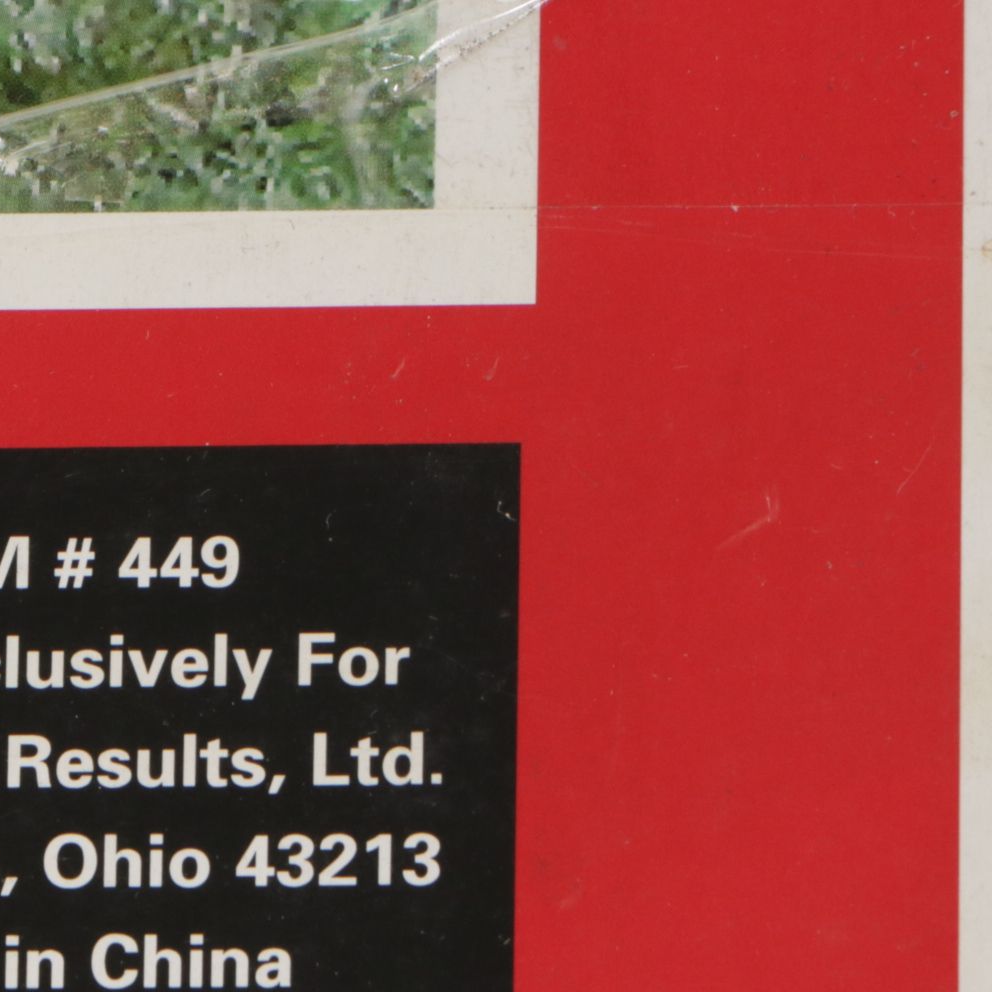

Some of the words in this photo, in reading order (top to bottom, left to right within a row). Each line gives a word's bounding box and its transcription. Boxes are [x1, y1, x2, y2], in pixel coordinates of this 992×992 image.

[54, 538, 95, 588] #
[119, 536, 239, 588] 449
[298, 633, 410, 686] For
[7, 734, 285, 794] Results,
[313, 732, 443, 786] Ltd.
[44, 833, 210, 889] Ohio
[236, 833, 440, 887] 43213
[5, 935, 64, 989] in
[91, 933, 291, 989] China
